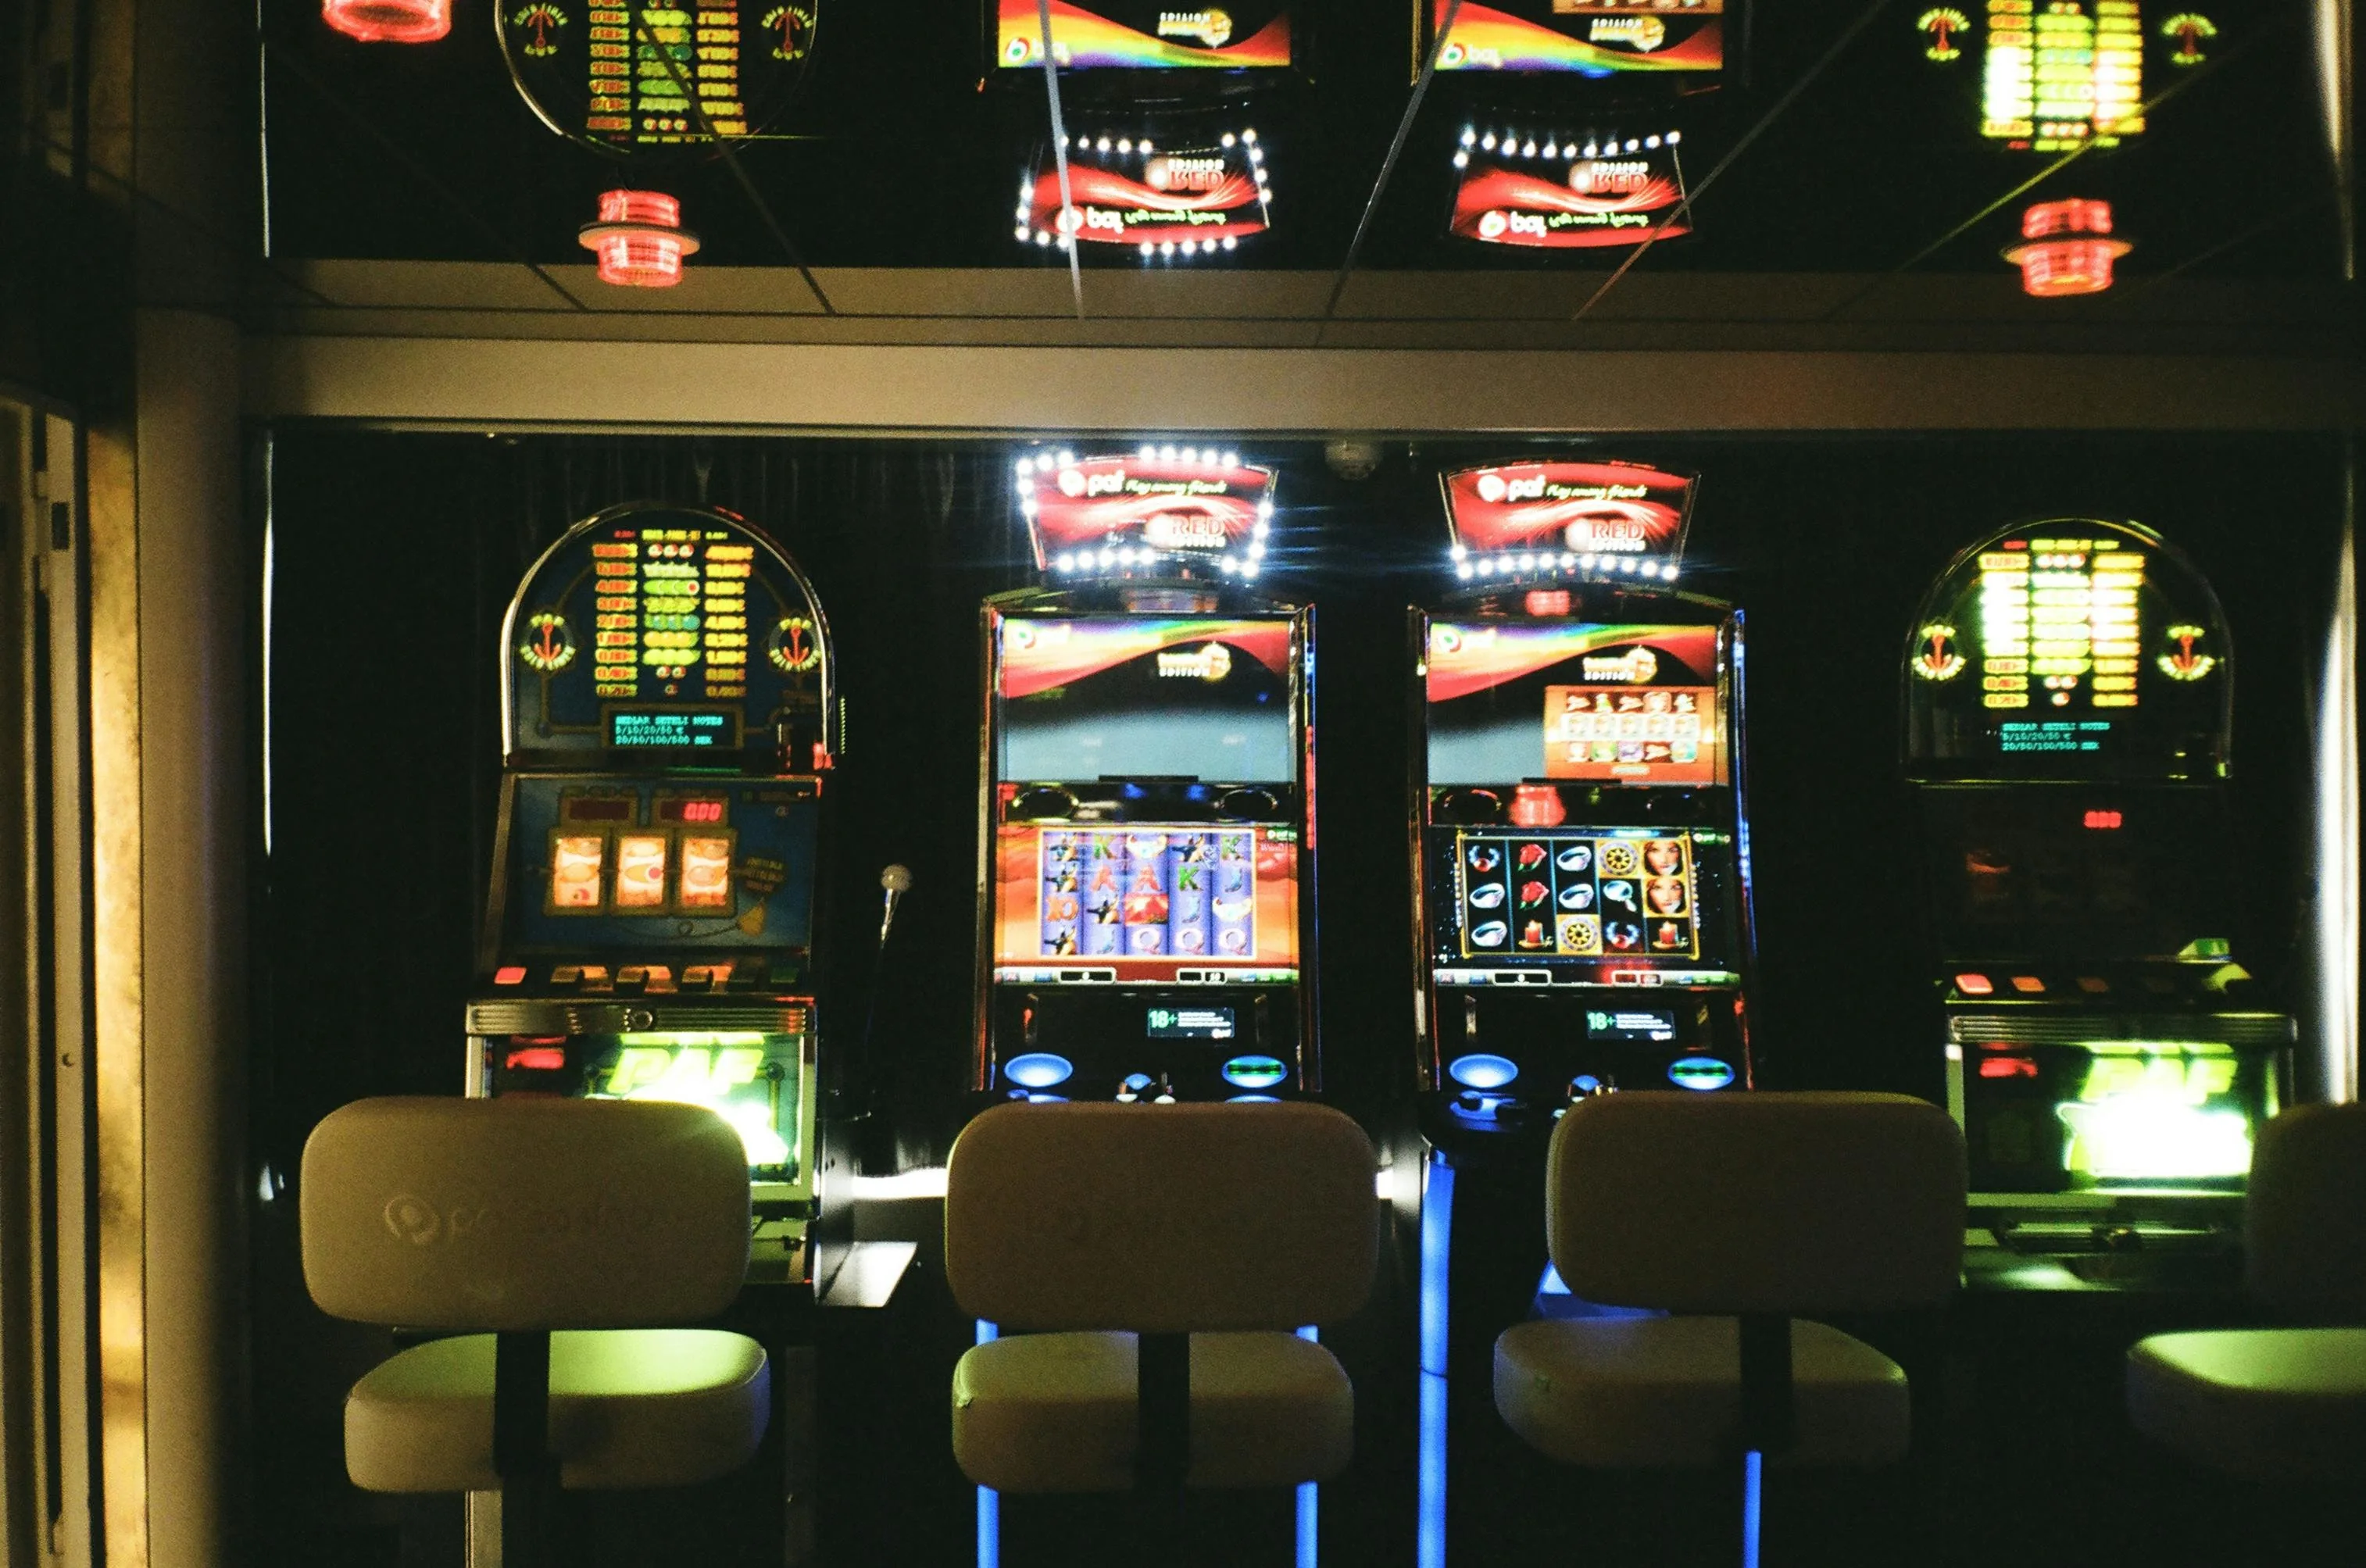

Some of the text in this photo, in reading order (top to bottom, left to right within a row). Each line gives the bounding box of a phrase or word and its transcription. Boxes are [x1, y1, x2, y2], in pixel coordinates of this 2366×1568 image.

[1088, 470, 1124, 496] paf
[1507, 474, 1546, 501] paf
[1172, 516, 1225, 536] RED
[1591, 520, 1645, 540] RED
[1149, 1010, 1177, 1028] 18+
[1588, 1012, 1615, 1030] 18+
[606, 1048, 764, 1095] PAF
